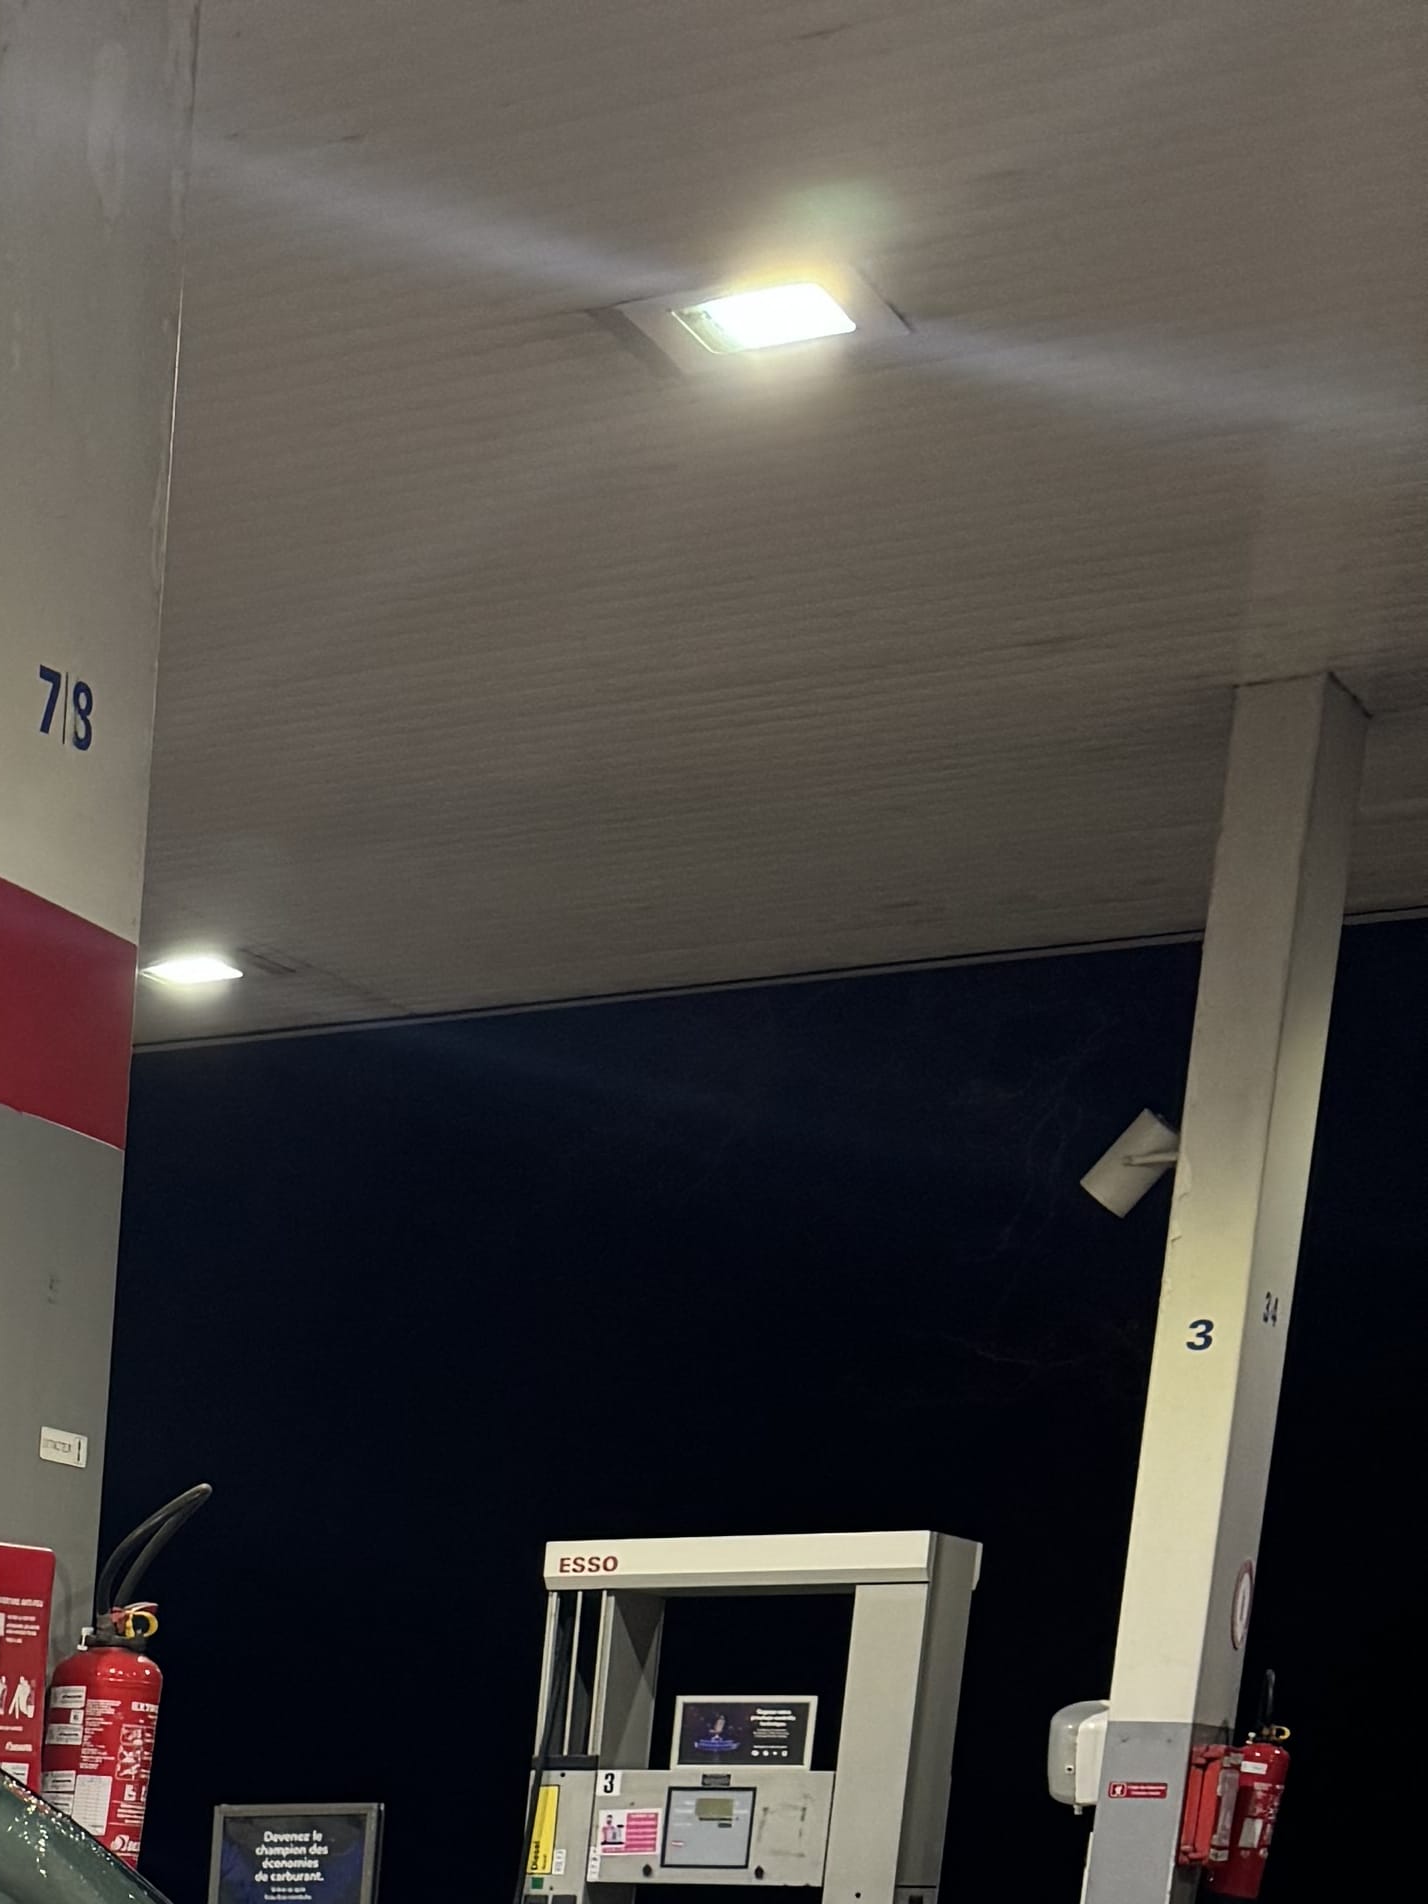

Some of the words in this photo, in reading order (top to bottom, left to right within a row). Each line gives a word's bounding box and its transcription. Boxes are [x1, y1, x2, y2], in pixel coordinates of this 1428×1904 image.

[1186, 1319, 1214, 1350] 3
[559, 1556, 618, 1573] ESSO
[604, 1772, 615, 1793] 3
[263, 1831, 311, 1842] Devenez
[255, 1843, 307, 1858] champion
[308, 1843, 329, 1855] des
[254, 1870, 268, 1882] de
